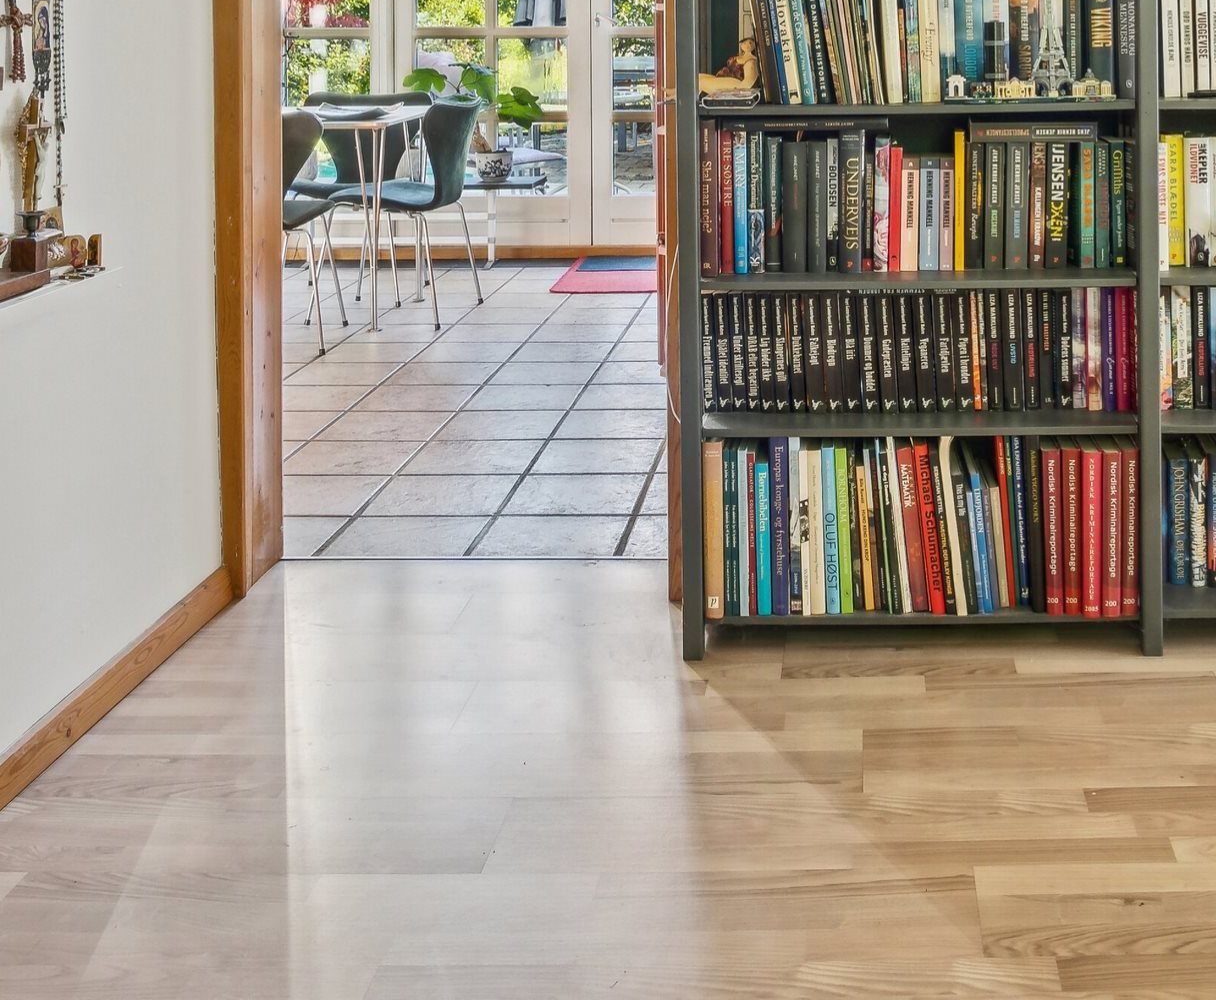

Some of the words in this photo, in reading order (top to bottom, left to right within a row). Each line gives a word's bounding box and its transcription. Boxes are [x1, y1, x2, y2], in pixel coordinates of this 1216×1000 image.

[793, 13, 800, 21] de
[810, 4, 821, 49] DANMARKS
[1091, 7, 1112, 47] VIKING
[1119, 3, 1128, 54] MENNESKE
[1127, 1, 1135, 41] MONARK
[1198, 11, 1208, 59] VUGGEVISE
[702, 160, 712, 181] Skal
[723, 140, 732, 161] TRE
[1169, 143, 1177, 173] SARA
[1190, 143, 1198, 184] ILDVIDNET
[1198, 149, 1208, 184] KEPLER
[723, 164, 732, 207] SØSTRE
[828, 165, 838, 207] BOLDSEN
[1112, 150, 1124, 195] Griffiths
[845, 157, 859, 250] UNDERVEJS
[1169, 178, 1178, 221] BLÆDEL
[989, 294, 997, 306] LIZA
[1008, 307, 1016, 339] MARKLUND
[703, 336, 713, 363] Fremmed
[774, 446, 784, 482] Europas
[918, 454, 933, 505] Michael
[1048, 459, 1057, 493] Nordisk
[1068, 459, 1076, 492] Nordisk
[1110, 461, 1118, 495] Nordisk
[1128, 460, 1136, 494] Nordisk
[1172, 466, 1185, 493] JOHN
[758, 472, 767, 532] Børnebibelen
[774, 485, 784, 514] konge-
[837, 468, 847, 523] BORNHOLM
[900, 463, 913, 508] MATEMATIK
[774, 518, 782, 527] og
[824, 512, 836, 549] OLUF
[1068, 494, 1077, 572] Kriminalreportage
[1174, 493, 1185, 536] GRISHAM
[775, 530, 784, 576] fyrstehuse
[925, 511, 941, 592] Schumacher
[1049, 496, 1058, 575] Kriminalreportage
[1108, 498, 1118, 578] Kriminalreportage
[1127, 496, 1136, 576] Kriminalreportage
[826, 554, 838, 591] HØST
